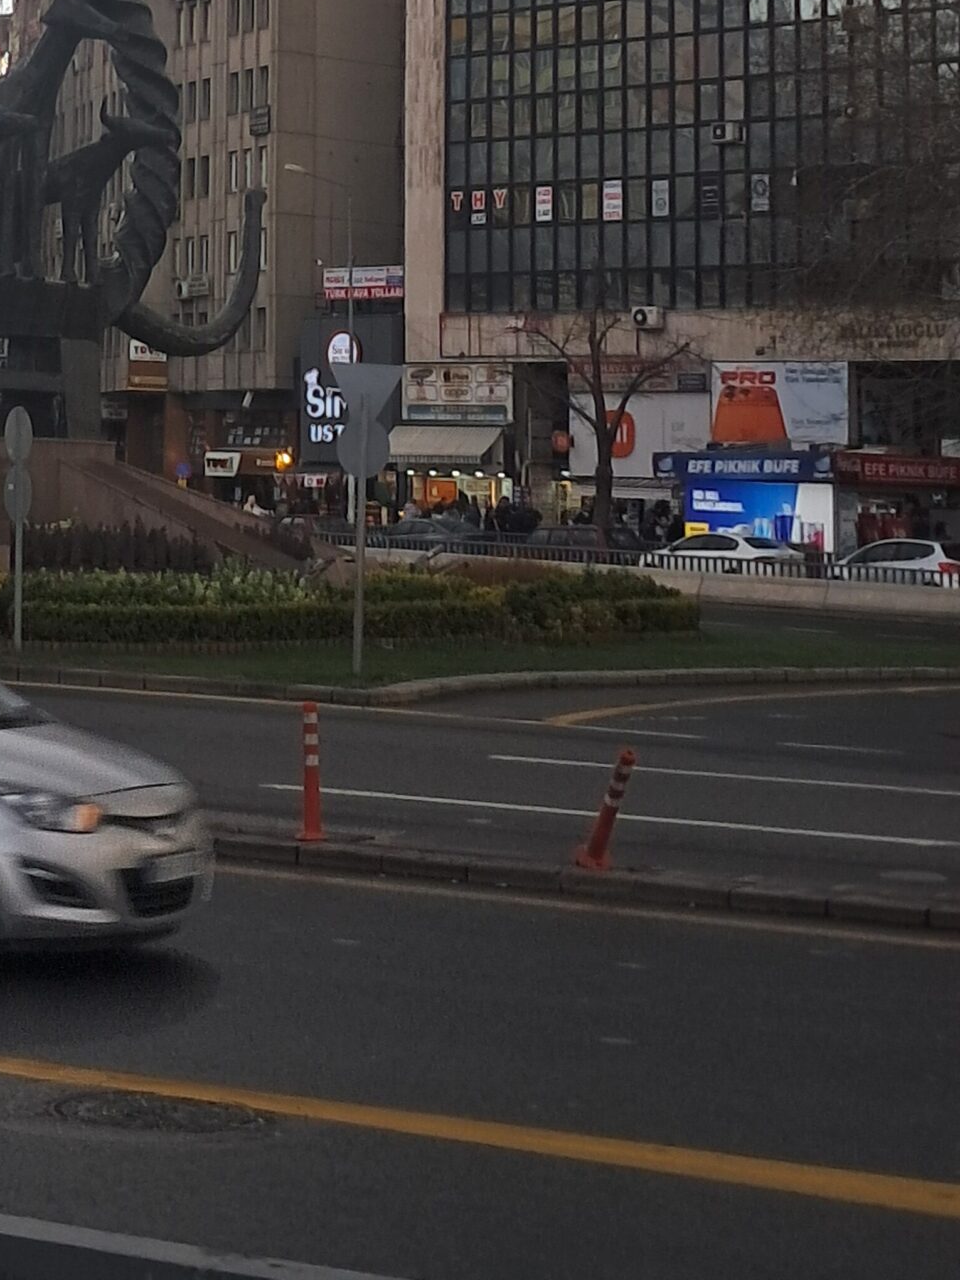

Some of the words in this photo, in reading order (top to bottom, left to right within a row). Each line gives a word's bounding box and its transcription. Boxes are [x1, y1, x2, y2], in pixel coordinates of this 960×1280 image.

[450, 188, 508, 211] THY
[721, 371, 777, 385] PRO
[687, 459, 713, 474] EFE
[864, 462, 887, 476] EFE
